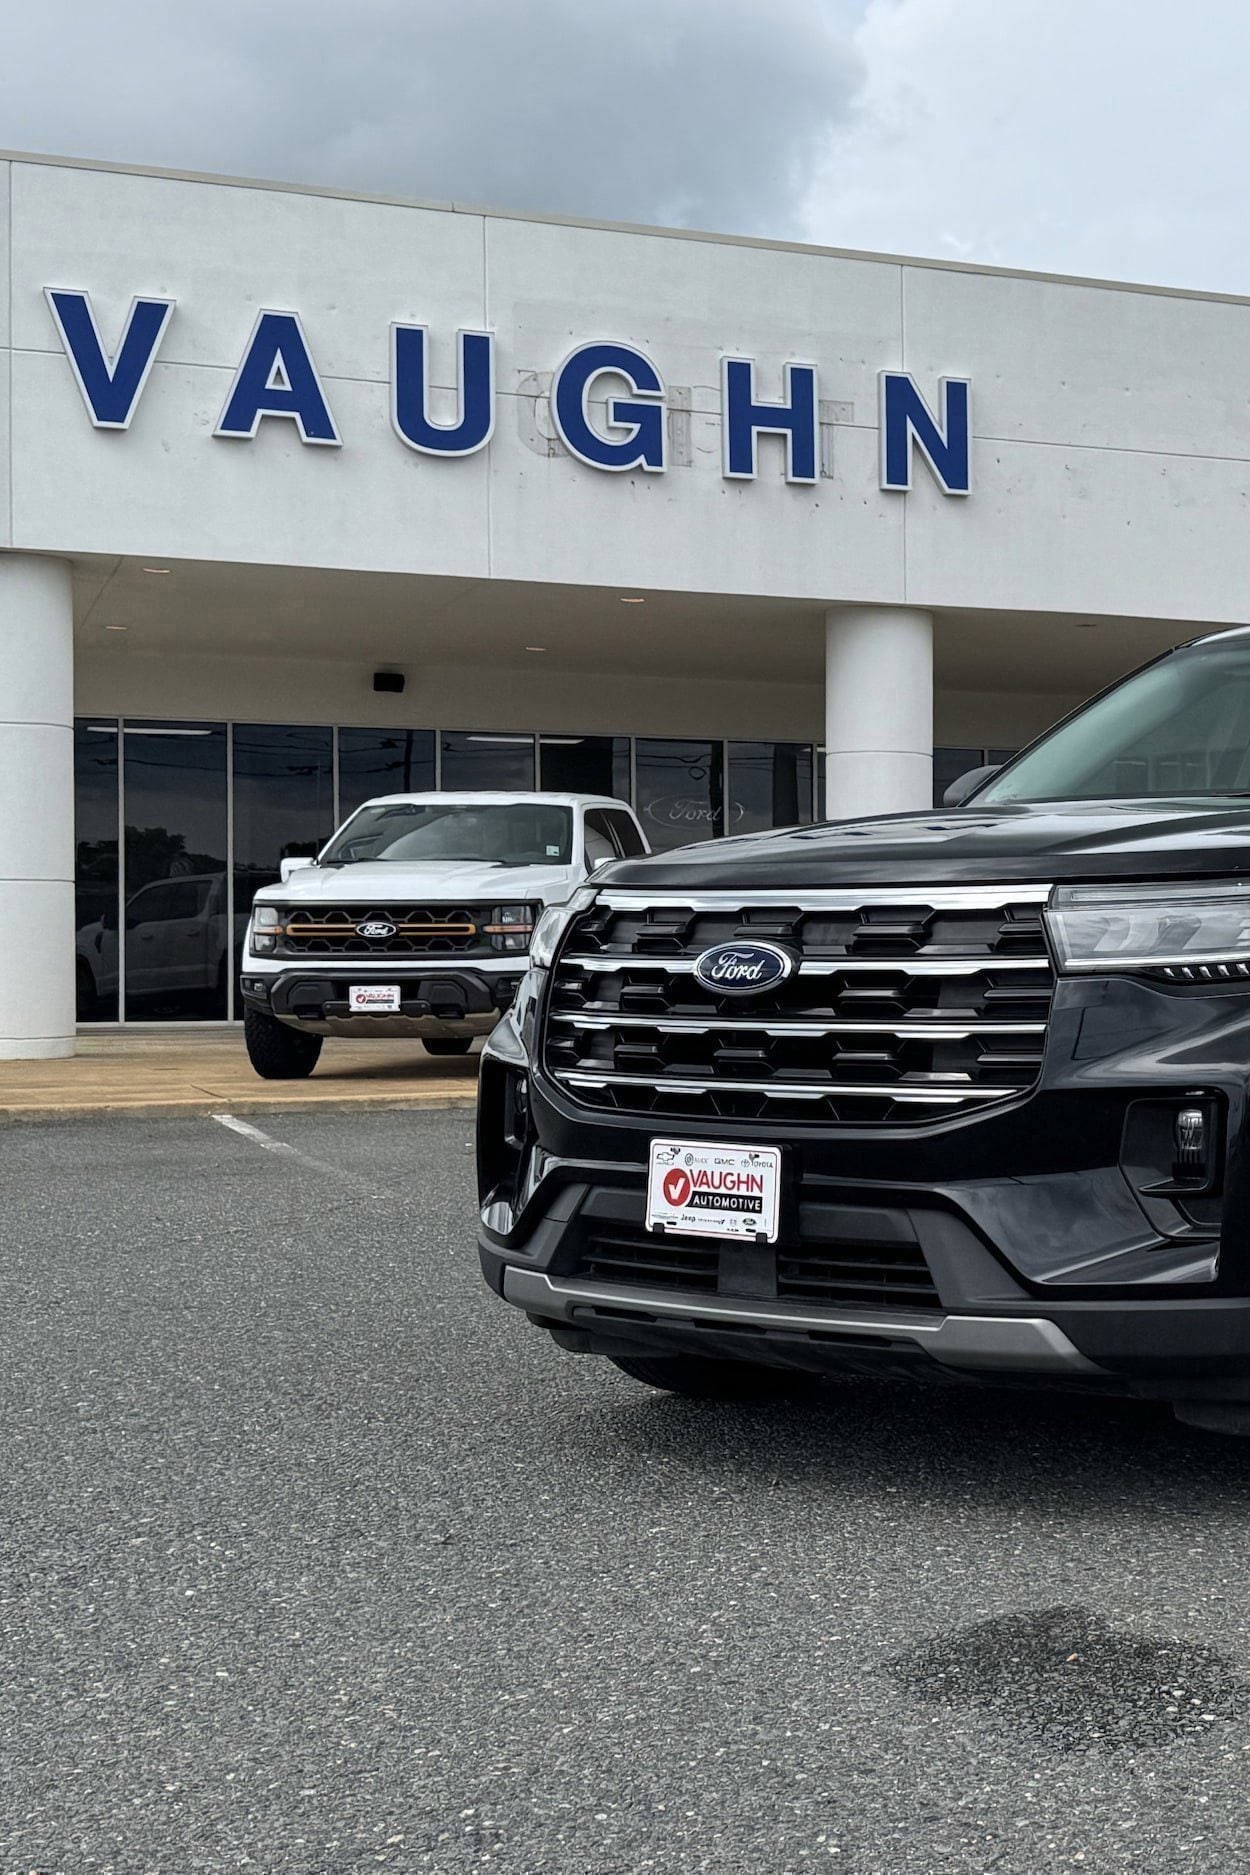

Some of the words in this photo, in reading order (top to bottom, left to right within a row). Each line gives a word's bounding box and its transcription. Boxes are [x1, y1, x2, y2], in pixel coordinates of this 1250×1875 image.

[42, 286, 974, 498] VAUGHN
[669, 799, 722, 821] Ford
[363, 923, 389, 935] Ford
[711, 951, 766, 980] Ford
[714, 1157, 736, 1166] GMC
[689, 1168, 763, 1194] VAUGHN
[692, 1194, 761, 1211] AUTOMOTIVE
[680, 1213, 697, 1223] Jeep
